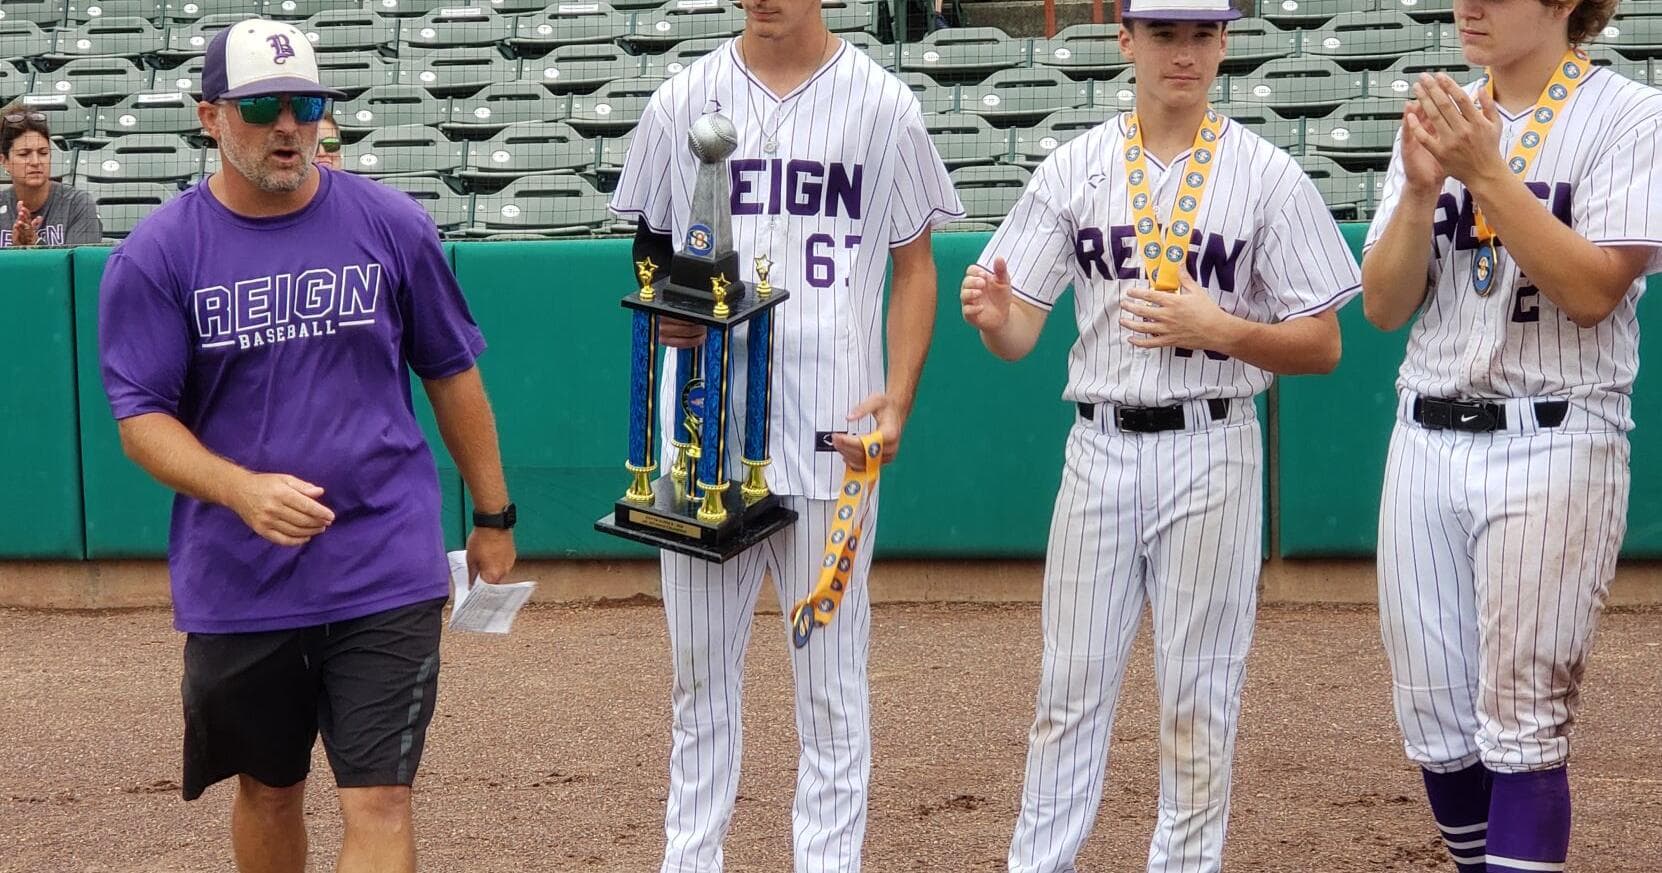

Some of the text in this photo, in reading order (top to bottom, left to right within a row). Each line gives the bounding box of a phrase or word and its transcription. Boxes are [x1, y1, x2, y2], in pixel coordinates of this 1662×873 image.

[266, 34, 296, 64] B
[730, 158, 863, 219] EIGN
[1076, 224, 1247, 293] REN
[194, 263, 382, 338] REIGN
[238, 319, 337, 350] BASEBALL
